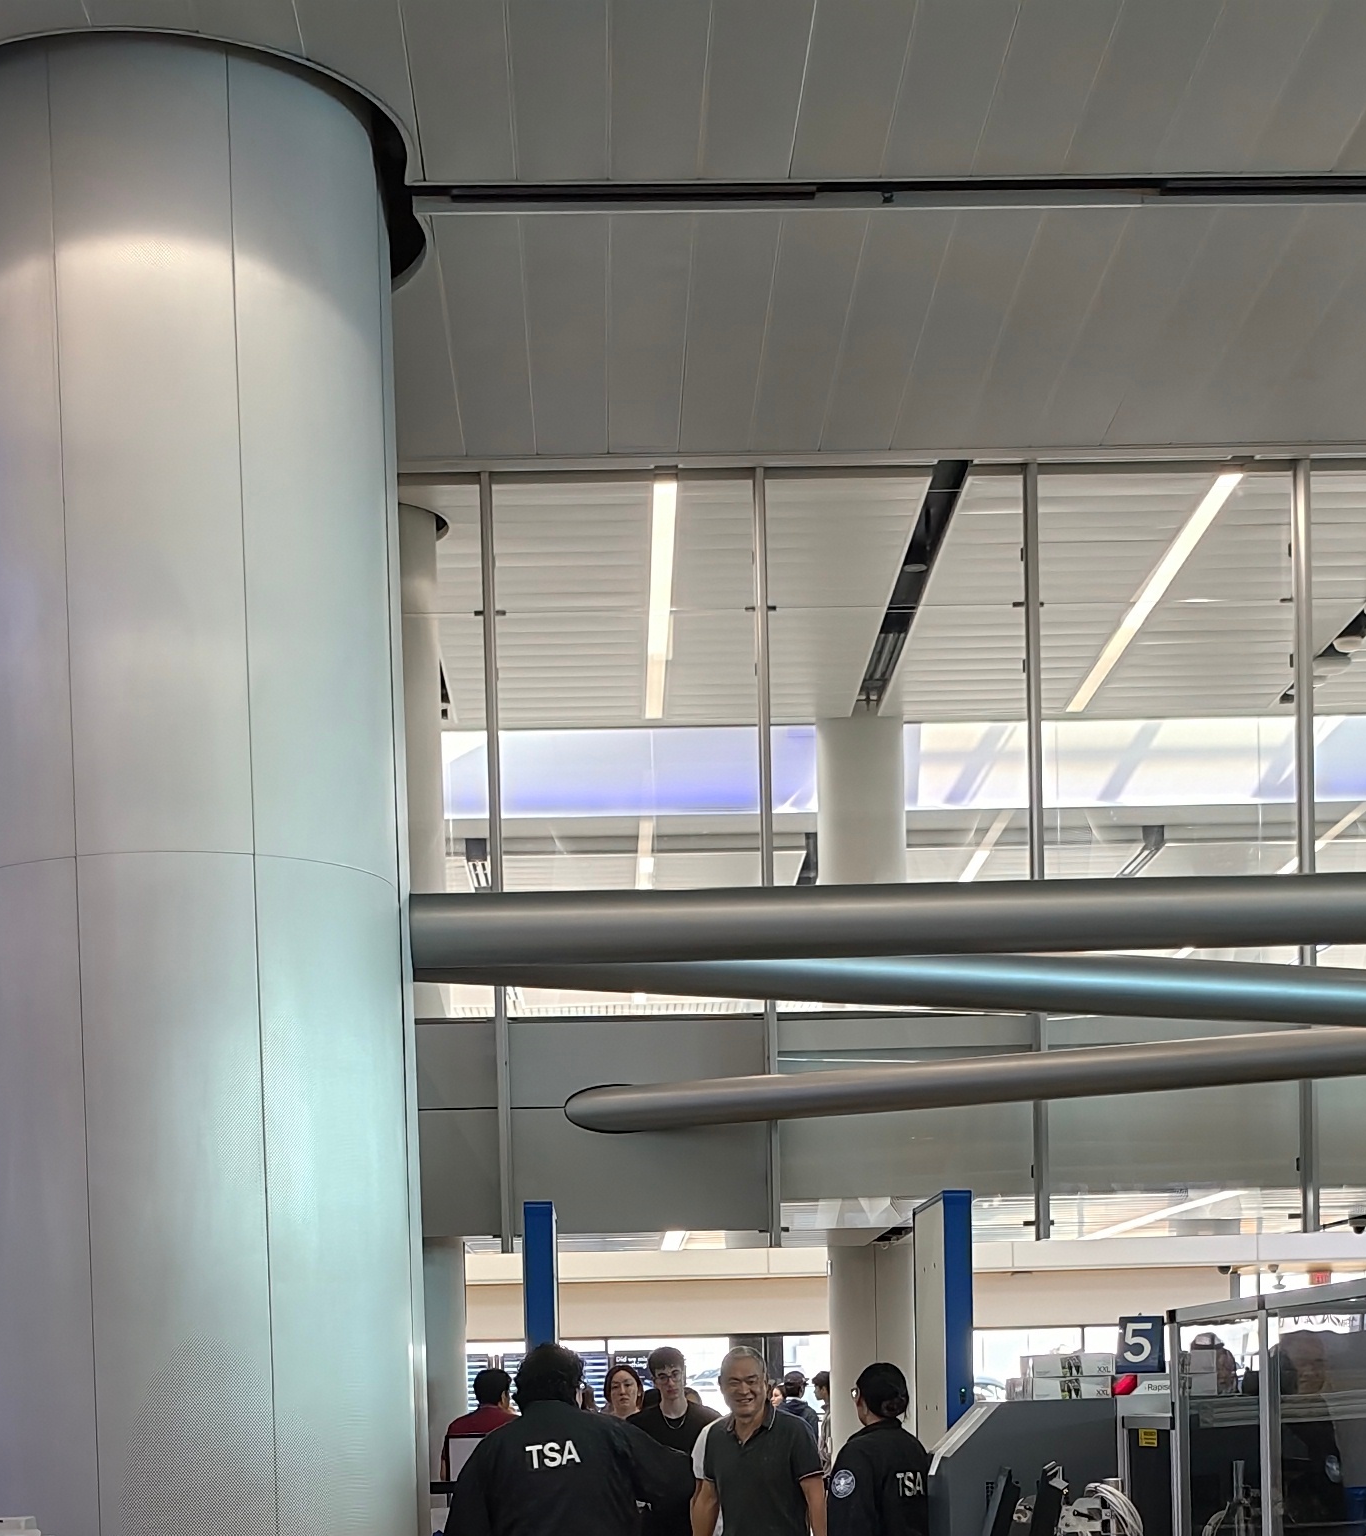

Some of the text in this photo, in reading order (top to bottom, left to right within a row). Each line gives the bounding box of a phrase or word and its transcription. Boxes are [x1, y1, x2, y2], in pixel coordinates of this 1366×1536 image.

[1122, 1322, 1152, 1363] 5
[615, 1355, 627, 1363] Did
[1096, 1365, 1112, 1374] XXL
[1095, 1388, 1110, 1397] XXL
[525, 1439, 582, 1470] TSA
[895, 1471, 926, 1497] TSA
